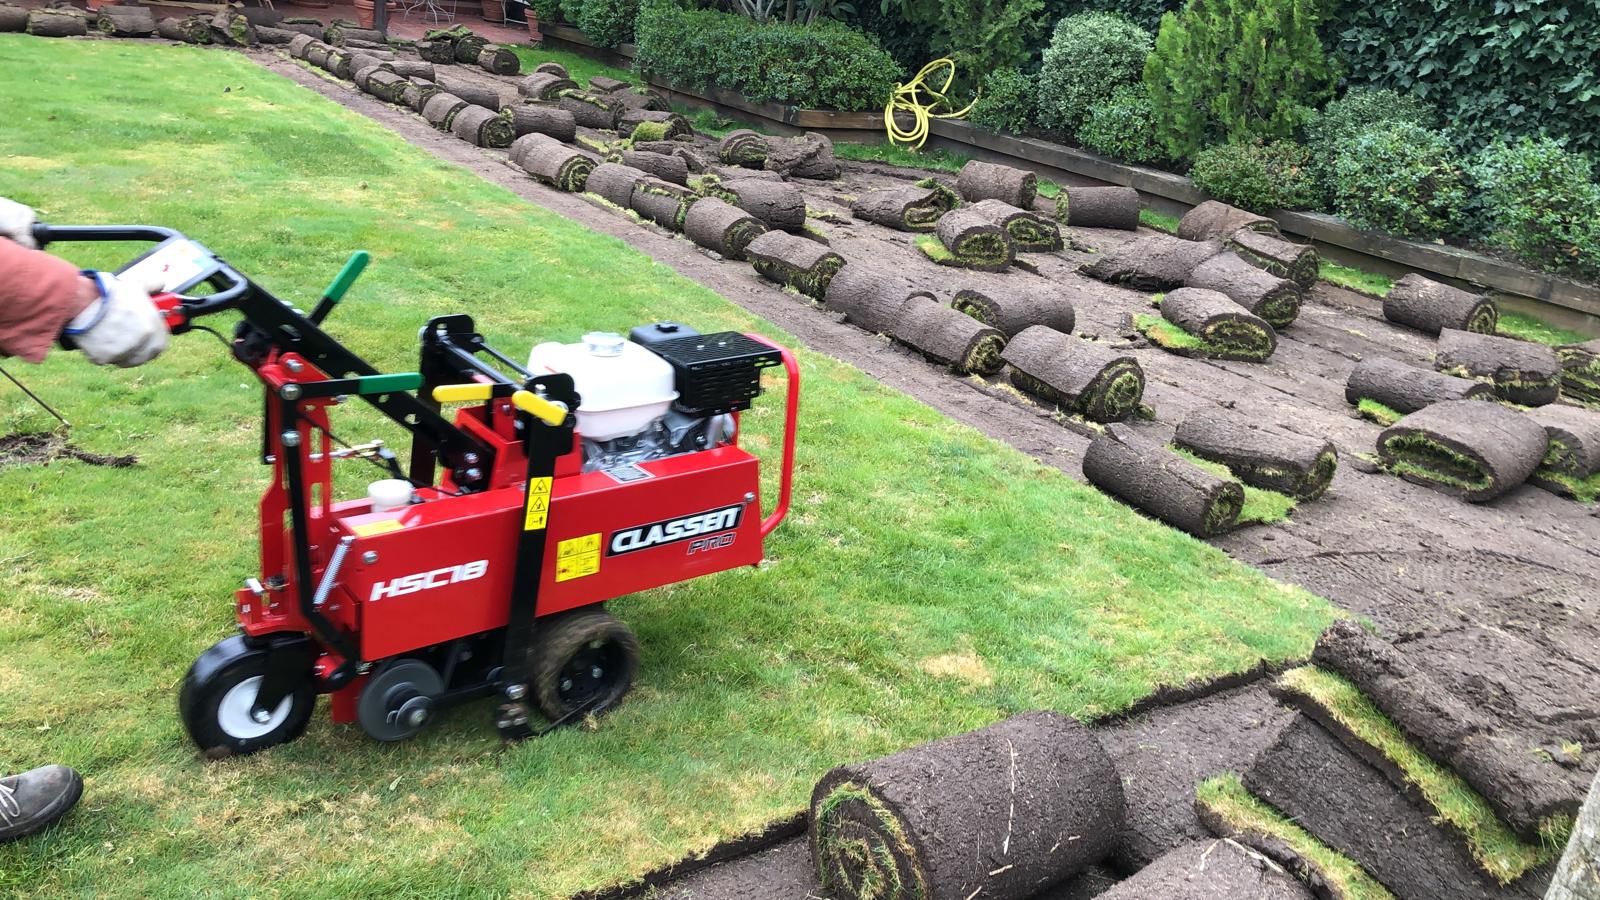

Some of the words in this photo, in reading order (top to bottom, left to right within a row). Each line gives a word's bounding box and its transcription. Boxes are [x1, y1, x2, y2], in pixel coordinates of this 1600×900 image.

[611, 506, 742, 553] CLASSEN
[686, 531, 737, 556] PRO
[369, 559, 490, 602] HSC18
